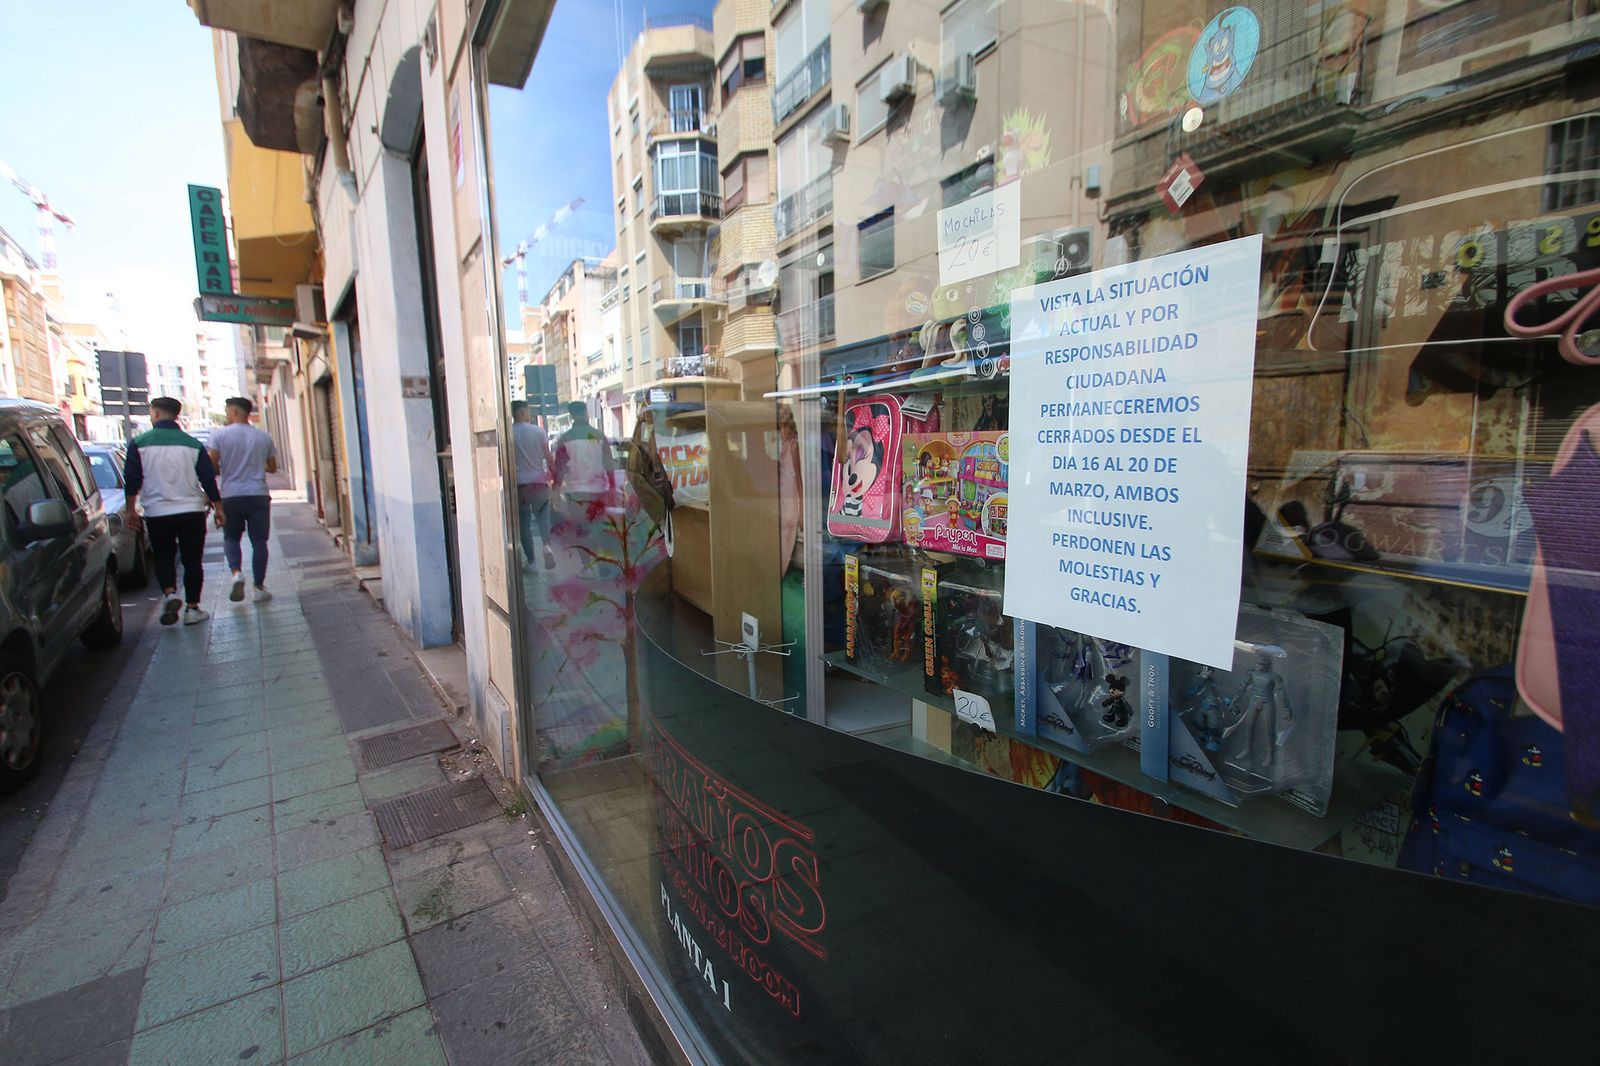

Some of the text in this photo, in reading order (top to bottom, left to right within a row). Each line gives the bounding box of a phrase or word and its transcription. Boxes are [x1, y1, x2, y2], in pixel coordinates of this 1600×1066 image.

[203, 252, 222, 290] BAR
[1040, 264, 1209, 312] VISTA LA SITUACIÓN
[1060, 303, 1178, 336] ACTUAL Y POR
[1045, 332, 1198, 365] RESPONSABILIDAD
[1066, 367, 1166, 390] CIUDADANA
[1041, 395, 1200, 418] PERMANECEREMOS
[1038, 427, 1202, 444] CERRADOS DESDE EL
[1053, 456, 1177, 473] DIA 16 AL 20 DE
[1050, 482, 1179, 503] MARZO, AMBOS
[1068, 508, 1152, 530] INCLUSIVE.
[935, 523, 978, 546] Pinypon
[1053, 533, 1171, 561] PERDONEN LAS
[1314, 527, 1501, 567] OGWARTS
[1059, 559, 1160, 588] MOLESTIAS Y
[923, 590, 934, 637] GOBLIN
[1070, 587, 1141, 613] GRACIAS.
[924, 637, 935, 677] GREEN
[1147, 664, 1155, 728] GOOFY & TRON
[660, 882, 718, 995] PLANTA
